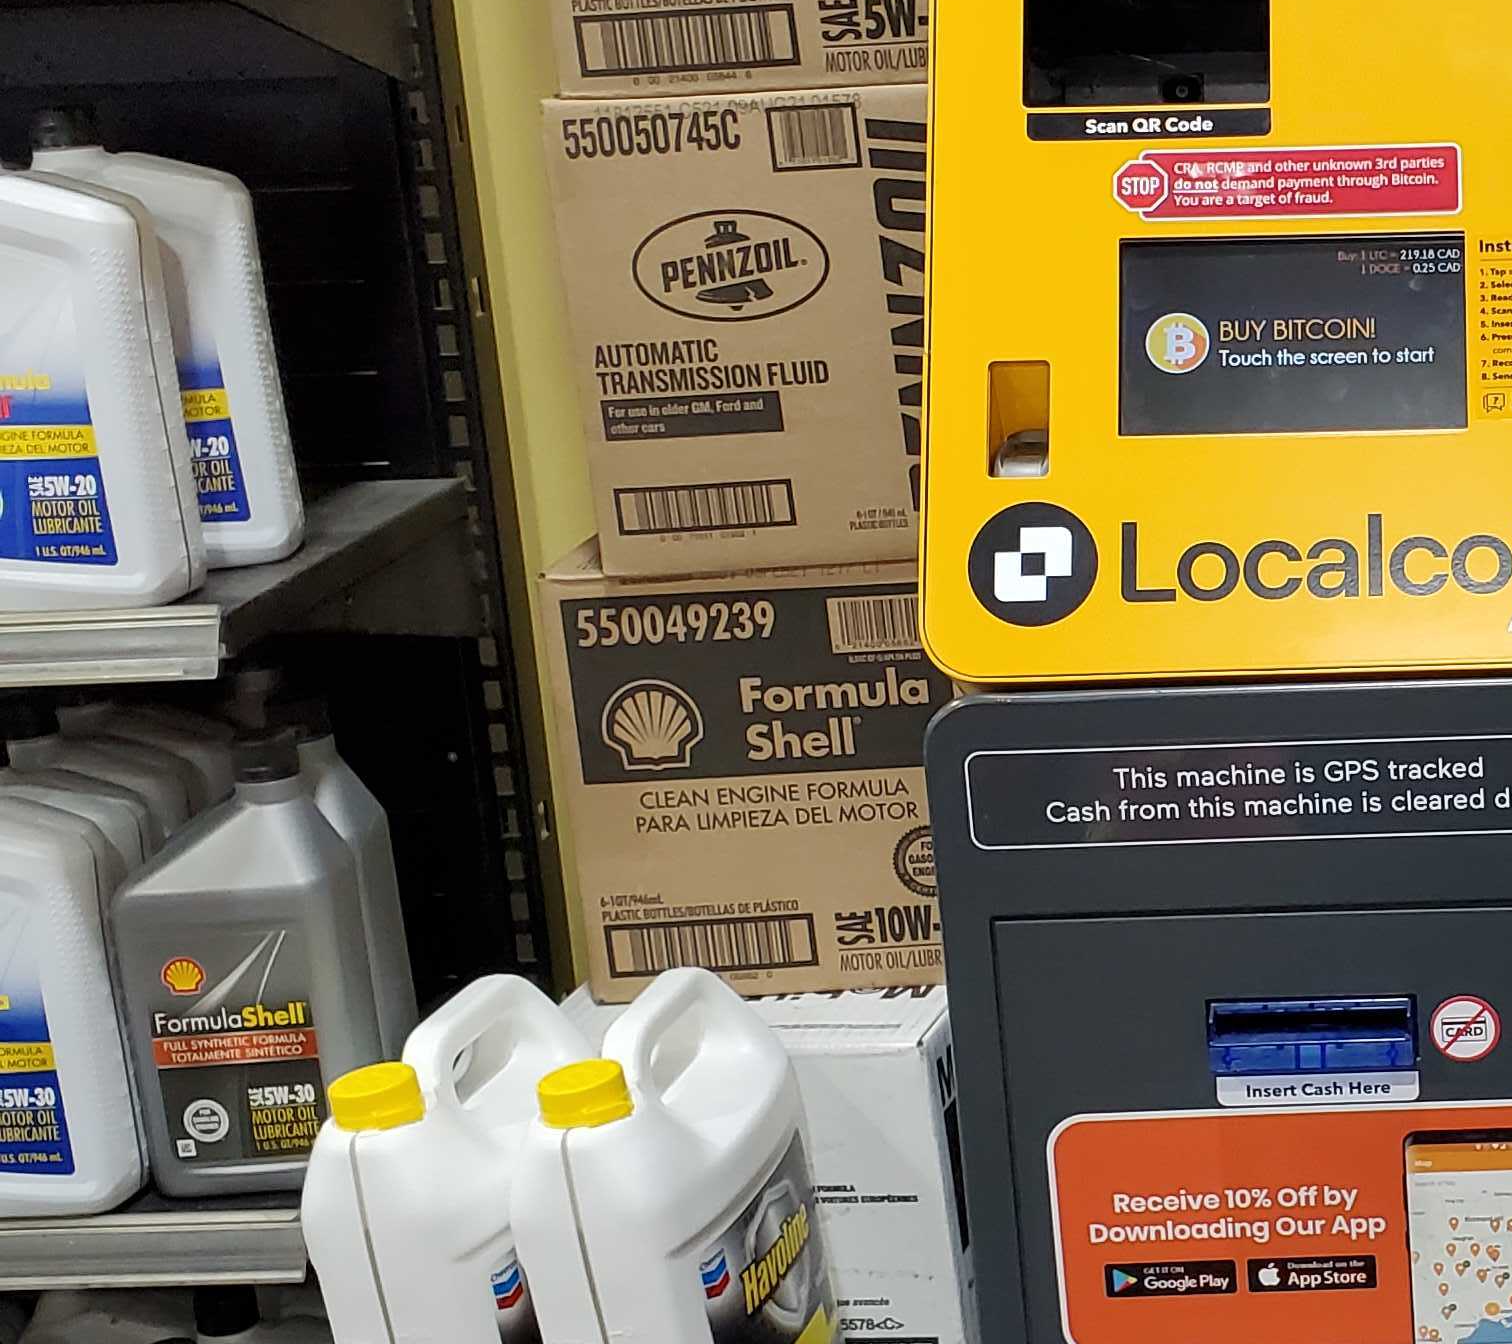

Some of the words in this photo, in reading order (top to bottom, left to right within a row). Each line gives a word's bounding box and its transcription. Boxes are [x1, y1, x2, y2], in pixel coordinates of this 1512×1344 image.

[562, 110, 741, 159] 550050745C
[1085, 117, 1129, 135] Scan
[1132, 116, 1161, 135] QR
[1166, 115, 1212, 133] Code
[1207, 162, 1243, 175] RCMP
[1248, 161, 1271, 173] and
[1275, 160, 1309, 172] other
[1313, 159, 1372, 171] unknown
[1376, 157, 1397, 170] 3rd
[1401, 157, 1444, 173] parties
[1121, 176, 1159, 195] STOP
[1174, 178, 1193, 191] do
[1199, 179, 1218, 191] not
[1222, 177, 1274, 190] demand
[1278, 175, 1335, 191] payment
[1338, 174, 1387, 189] through
[1392, 173, 1439, 186] Bitcoin.
[1174, 194, 1199, 207] You
[1202, 196, 1223, 206] are
[1227, 196, 1234, 205] a
[1237, 192, 1275, 208] target
[1279, 192, 1292, 204] of
[1295, 190, 1332, 204] fraud.
[661, 237, 800, 293] PENNZOIL
[1438, 249, 1460, 259] CAD
[1413, 263, 1436, 273] 0.25
[1439, 262, 1460, 273] CAD
[1219, 321, 1264, 341] BUY
[1274, 318, 1376, 340] BITCOIN!
[595, 338, 719, 369] AUTOMATIC
[1220, 351, 1272, 367] Touch
[1277, 350, 1305, 366] the
[1310, 352, 1367, 365] screen
[1373, 350, 1391, 363] to
[1397, 347, 1434, 363] start
[596, 365, 762, 396] TRANSMISSION
[767, 360, 829, 387] FLUID
[44, 473, 97, 497] 5W-20
[32, 499, 74, 517] MOTOR
[79, 499, 100, 516] OIL
[33, 516, 103, 535] LUBRICANTE
[576, 600, 776, 648] 550049239
[739, 666, 929, 714] Formula
[745, 716, 855, 761] Shell
[1113, 766, 1170, 790] This
[1177, 762, 1285, 789] machine
[1294, 761, 1314, 784] is
[1324, 758, 1379, 784] GPS
[1388, 755, 1484, 781] tracked
[640, 787, 709, 810] CLEAN
[717, 784, 799, 806] ENGINE
[808, 778, 908, 800] FORMULA
[1046, 798, 1111, 824] Cash
[1119, 796, 1180, 821] from
[1188, 794, 1236, 819] this
[1244, 791, 1352, 817] machine
[1361, 790, 1381, 813] is
[1390, 787, 1486, 812] cleared
[637, 812, 689, 833] PARA
[698, 808, 790, 830] LIMPIEZA
[795, 806, 833, 825] DEL
[839, 801, 919, 822] MOTOR
[163, 1039, 187, 1052] FULL
[190, 1035, 248, 1049] SYNTHETIC
[253, 1032, 306, 1046] FORMULA
[1445, 1023, 1483, 1039] CARD
[1246, 1082, 1296, 1098] Insert
[1302, 1081, 1347, 1097] Cash
[1352, 1080, 1390, 1095] Here
[1113, 1189, 1218, 1215] Receive
[1225, 1188, 1272, 1211] 10%
[1277, 1186, 1318, 1209] Off
[1324, 1184, 1358, 1212] by
[1089, 1217, 1269, 1248] Downloading
[1276, 1215, 1326, 1239] Our
[1332, 1214, 1386, 1242] App
[741, 1203, 809, 1315] Havoline
[1144, 1274, 1193, 1293] Google
[1199, 1272, 1229, 1292] Play
[1288, 1269, 1318, 1288] App
[1323, 1267, 1366, 1286] Store
